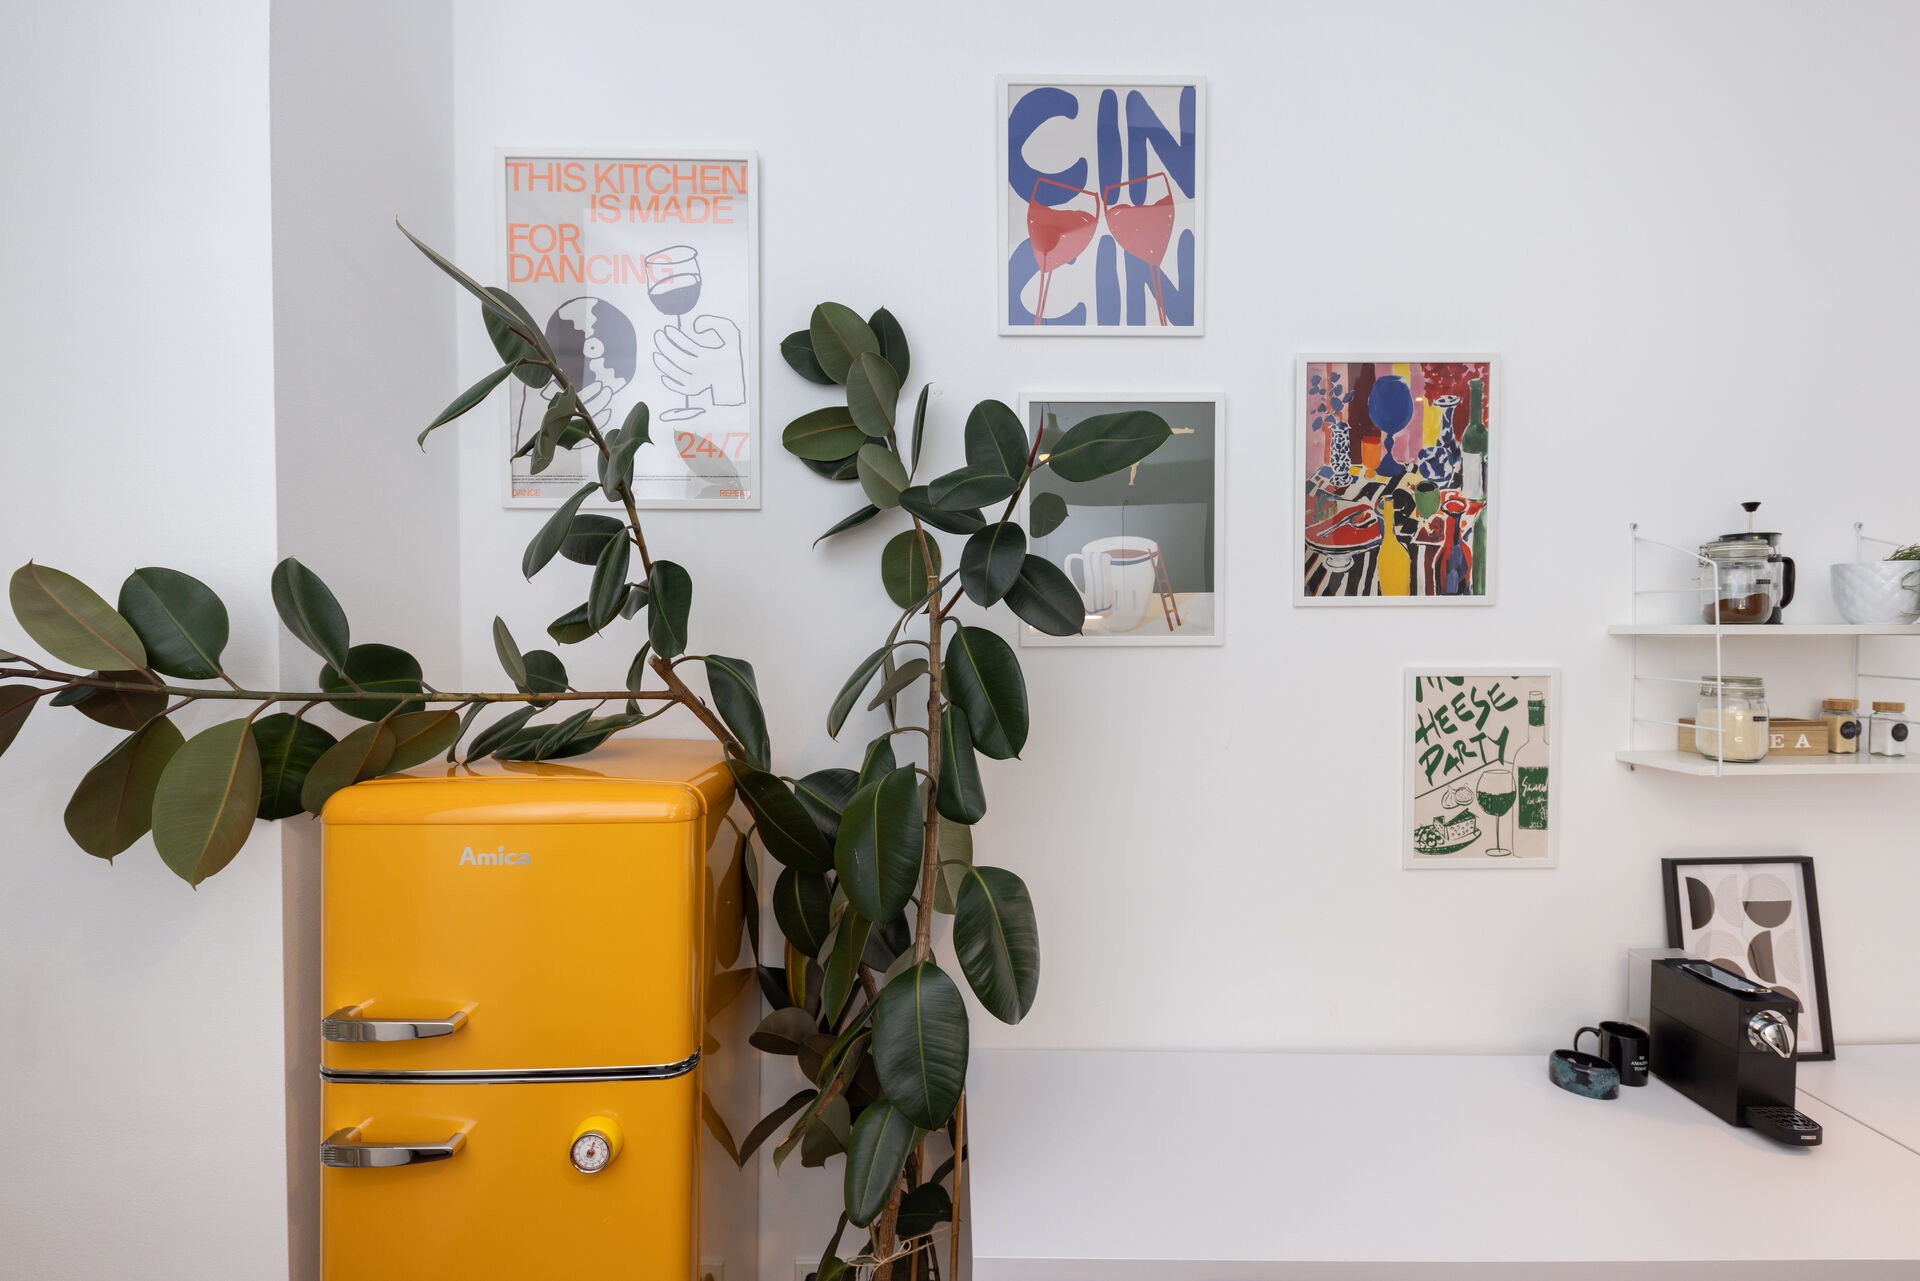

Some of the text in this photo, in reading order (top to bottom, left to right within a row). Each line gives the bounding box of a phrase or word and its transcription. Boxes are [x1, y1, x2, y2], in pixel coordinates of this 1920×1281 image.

[1008, 86, 1195, 206] CIN
[506, 162, 747, 195] THIS KITCHEN
[590, 194, 734, 224] IS MADE
[508, 223, 583, 254] FOR
[508, 254, 675, 285] DANCING
[677, 432, 750, 459] 24/7
[512, 488, 541, 497] DANCE
[1415, 682, 1519, 746] HEESE
[1418, 725, 1510, 787] PARTY
[458, 845, 531, 866] Amica
